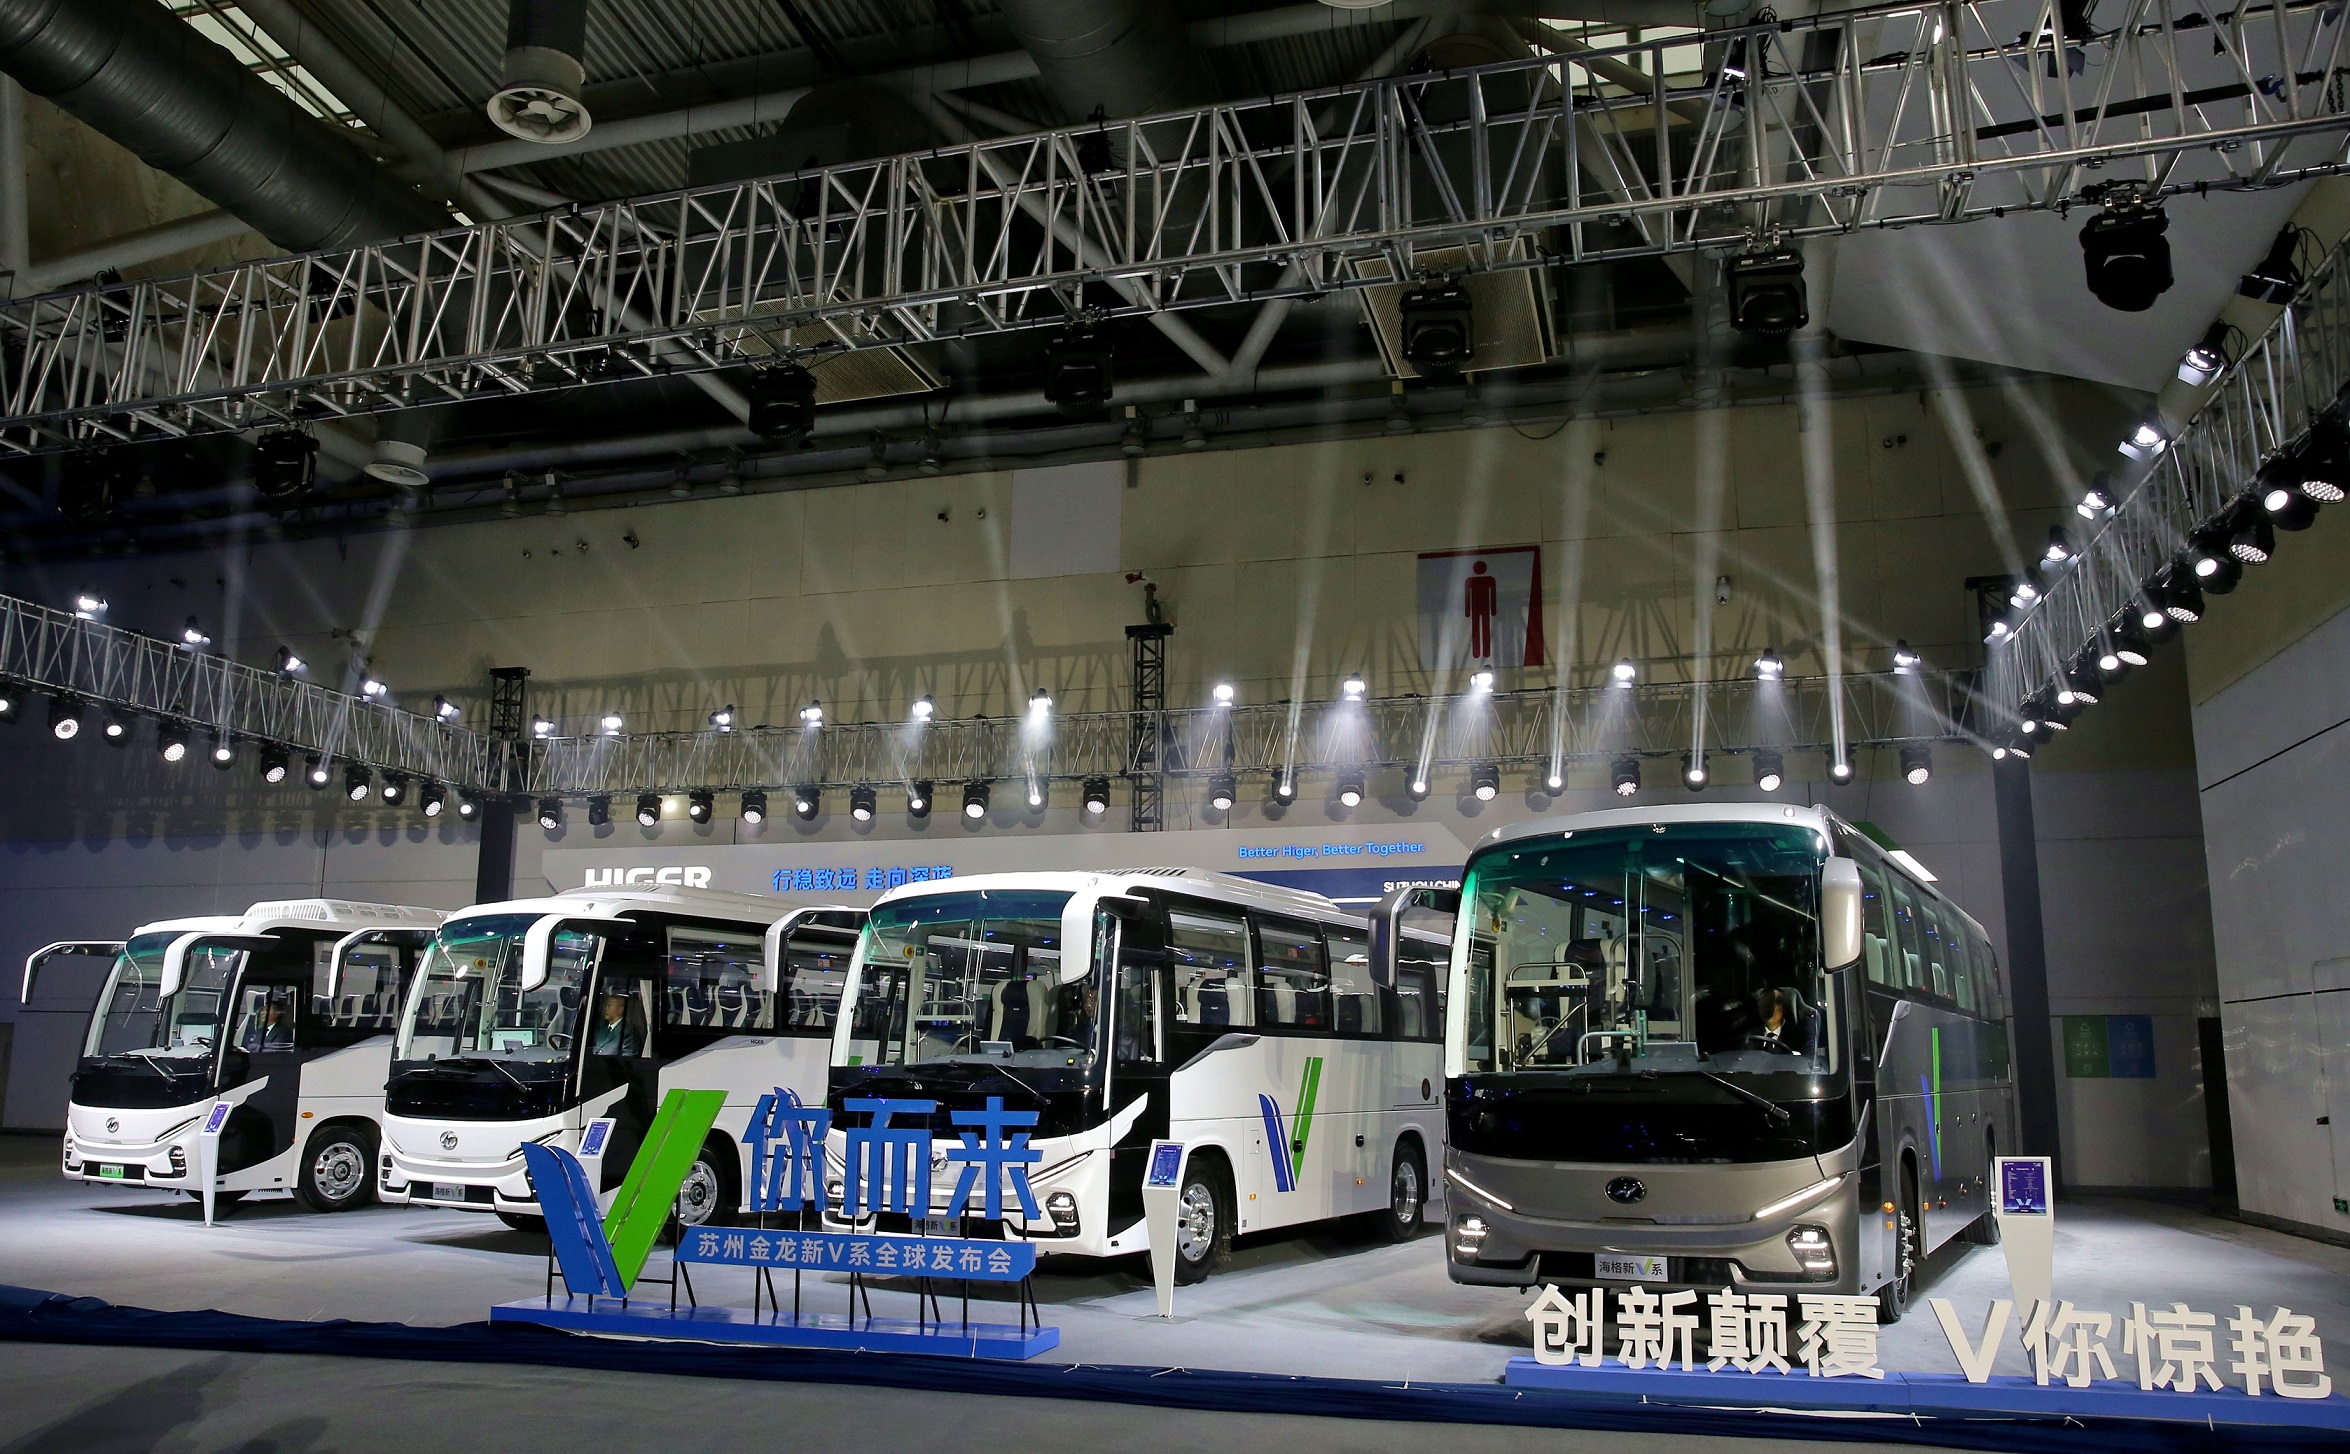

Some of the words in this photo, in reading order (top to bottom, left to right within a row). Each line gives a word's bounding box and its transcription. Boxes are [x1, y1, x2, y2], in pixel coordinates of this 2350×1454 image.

[1239, 846, 1279, 858] Better
[1282, 846, 1319, 859] Higer,
[1323, 844, 1362, 856] Better
[1365, 842, 1425, 856] Together.
[585, 867, 711, 889] HIGER
[773, 869, 857, 891] 行稳致远
[699, 1232, 1012, 1274] 苏州金龙新V系全球发布会
[1599, 1258, 1662, 1276] 海格新V系
[1525, 1283, 1885, 1379] 创新颠覆
